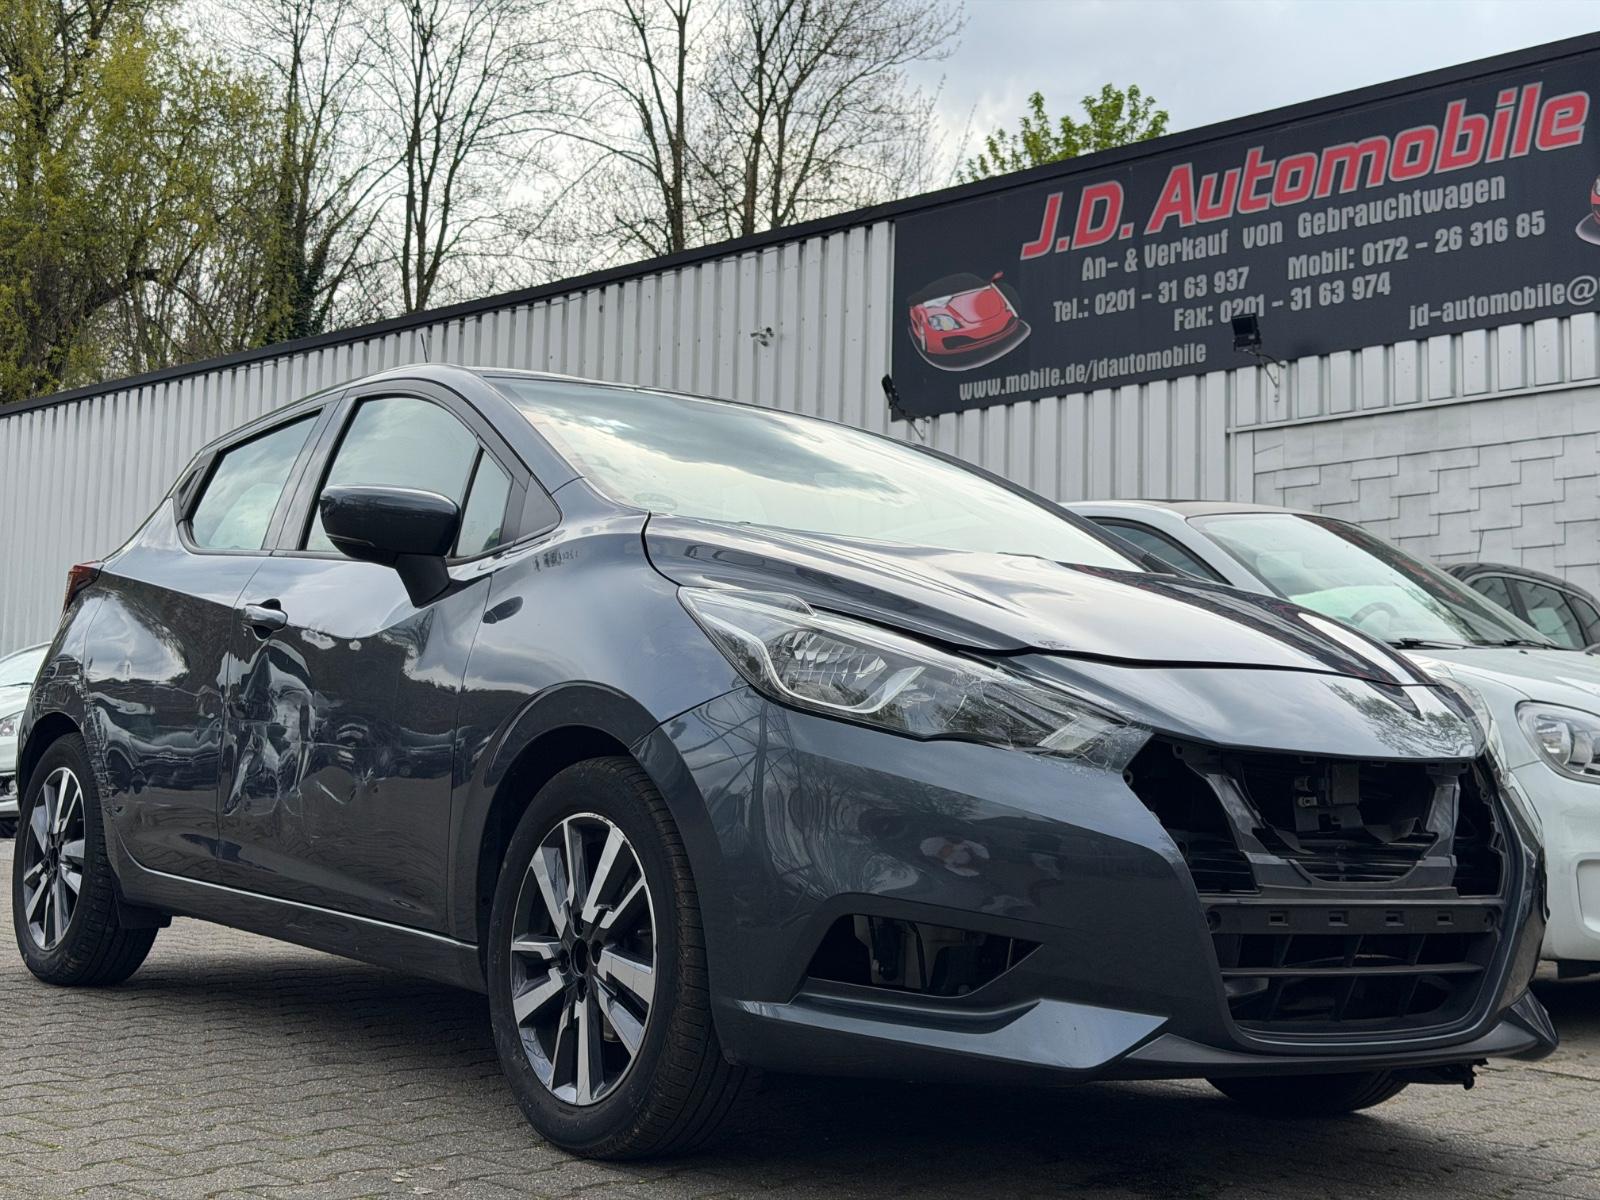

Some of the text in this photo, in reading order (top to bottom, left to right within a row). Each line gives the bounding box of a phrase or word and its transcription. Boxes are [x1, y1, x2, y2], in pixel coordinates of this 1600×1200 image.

[1020, 82, 1590, 260] J.D. Automobile
[1081, 175, 1506, 282] An- & Verkauf von Gebrauchtwagen
[1287, 246, 1355, 281] Mobil:
[1362, 235, 1409, 267] 0172
[1434, 225, 1463, 254] 26
[1469, 217, 1509, 247] 316
[1515, 210, 1546, 239] 85
[1053, 297, 1089, 323] Tel.:
[1094, 287, 1136, 316] 0201
[1158, 279, 1178, 304] 31
[1183, 274, 1208, 299] 63
[1213, 266, 1250, 294] 937
[1173, 305, 1214, 332] Fax:
[1290, 285, 1312, 312] 31
[1318, 279, 1345, 306] 63
[1351, 271, 1391, 301] 974
[1408, 275, 1600, 331] jd-automobile@
[959, 342, 1207, 401] www.mobile.de/jdautomobile
